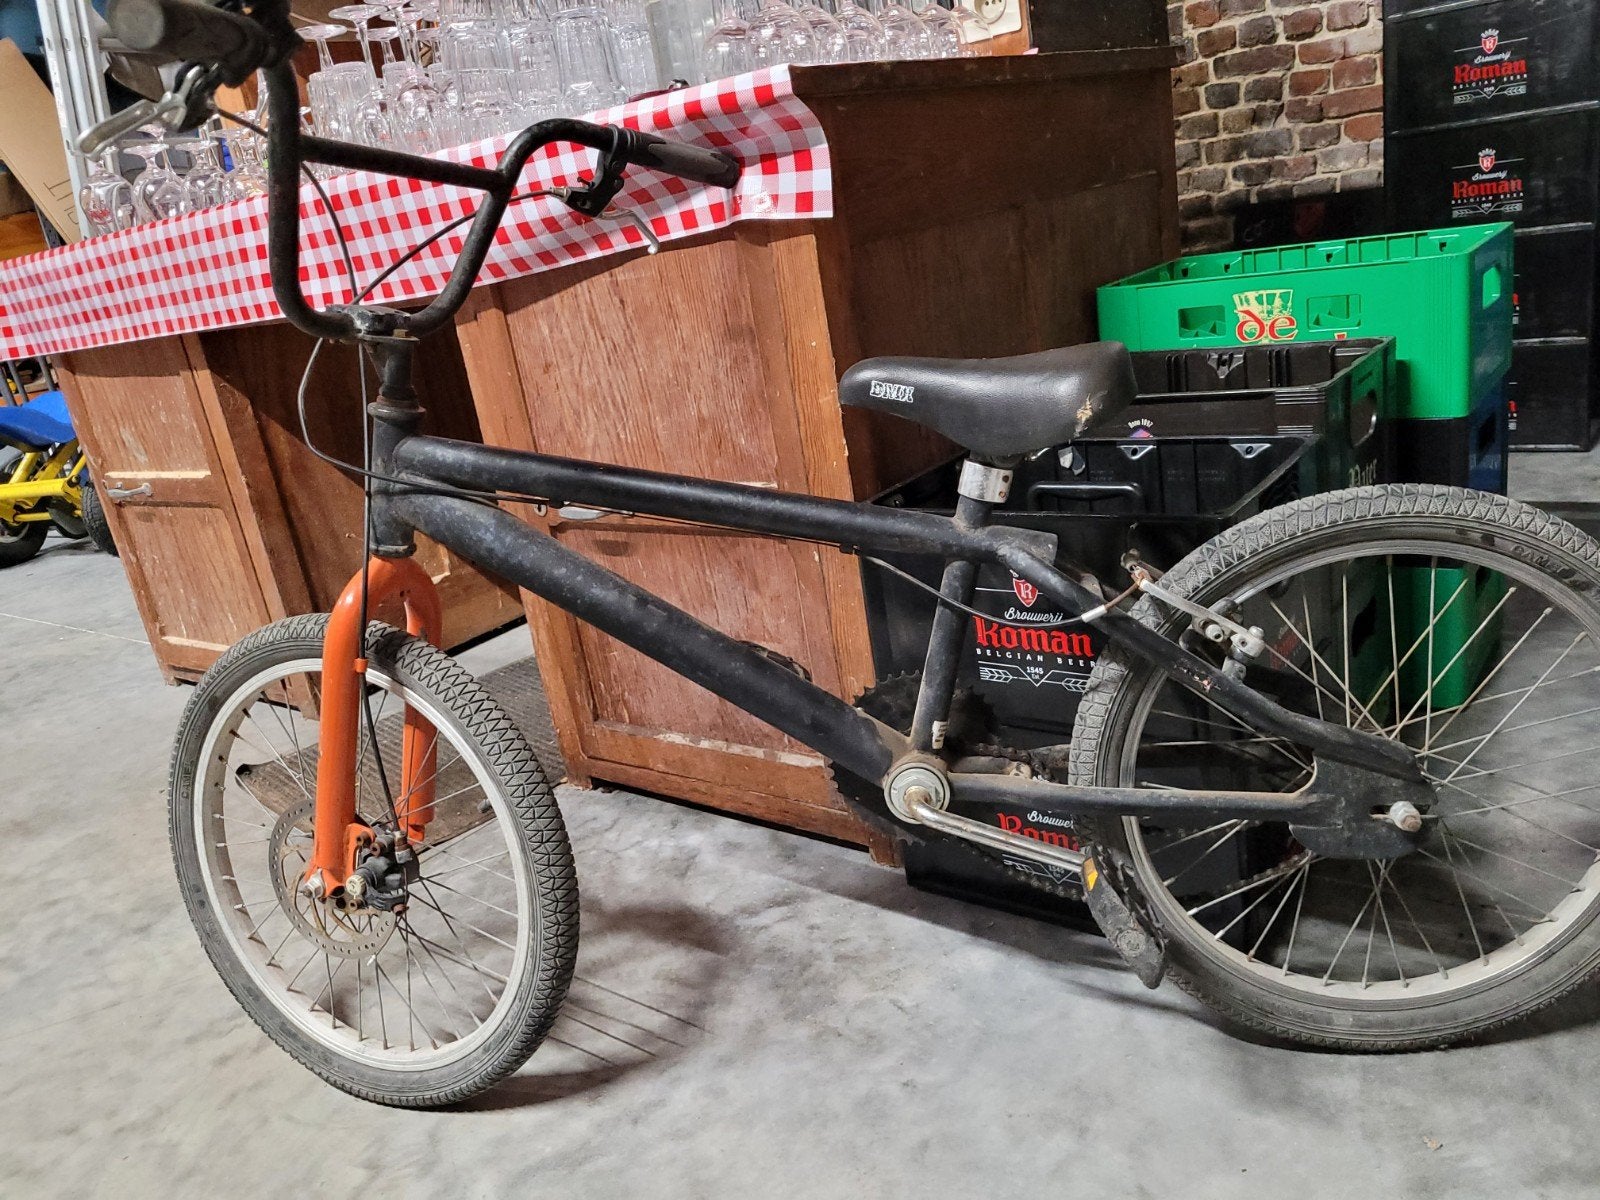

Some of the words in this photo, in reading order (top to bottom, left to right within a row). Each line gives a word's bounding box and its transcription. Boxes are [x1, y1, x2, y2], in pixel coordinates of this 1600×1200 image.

[1453, 60, 1526, 84] Roman
[1453, 179, 1522, 199] Roman
[1004, 607, 1063, 622] Brouwerij
[972, 615, 1095, 657] Roman
[975, 648, 1043, 662] BELGIAN
[1057, 657, 1097, 668] BEER
